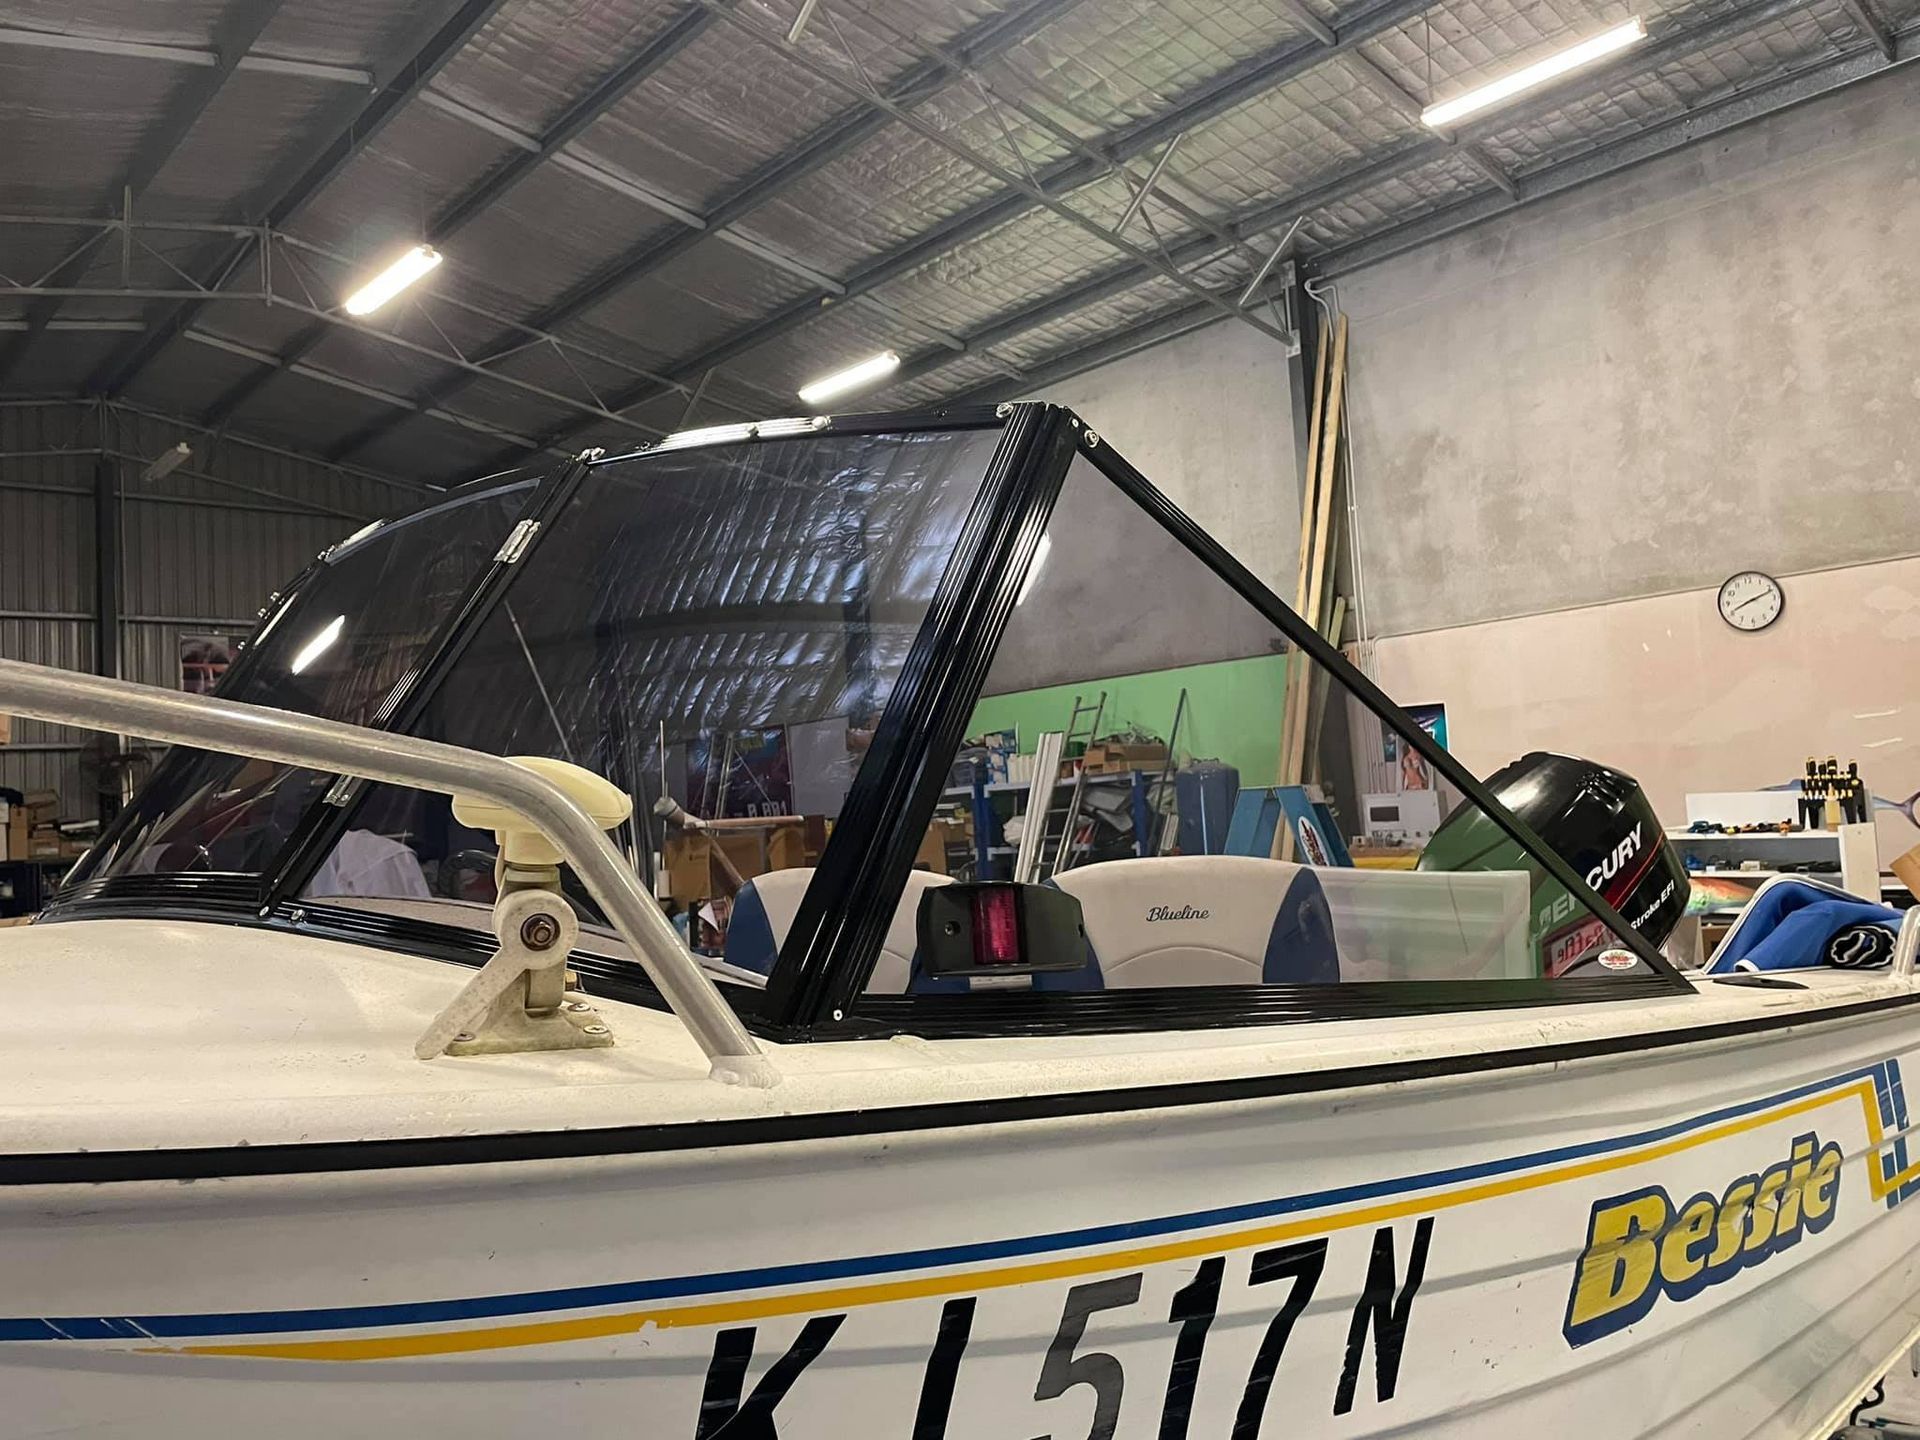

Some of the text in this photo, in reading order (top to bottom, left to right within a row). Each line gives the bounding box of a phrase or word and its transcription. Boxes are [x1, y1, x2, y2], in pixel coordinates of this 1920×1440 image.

[1660, 879, 1675, 903] EFI
[1145, 904, 1210, 922] Blueline
[1564, 1132, 1844, 1349] Bessie
